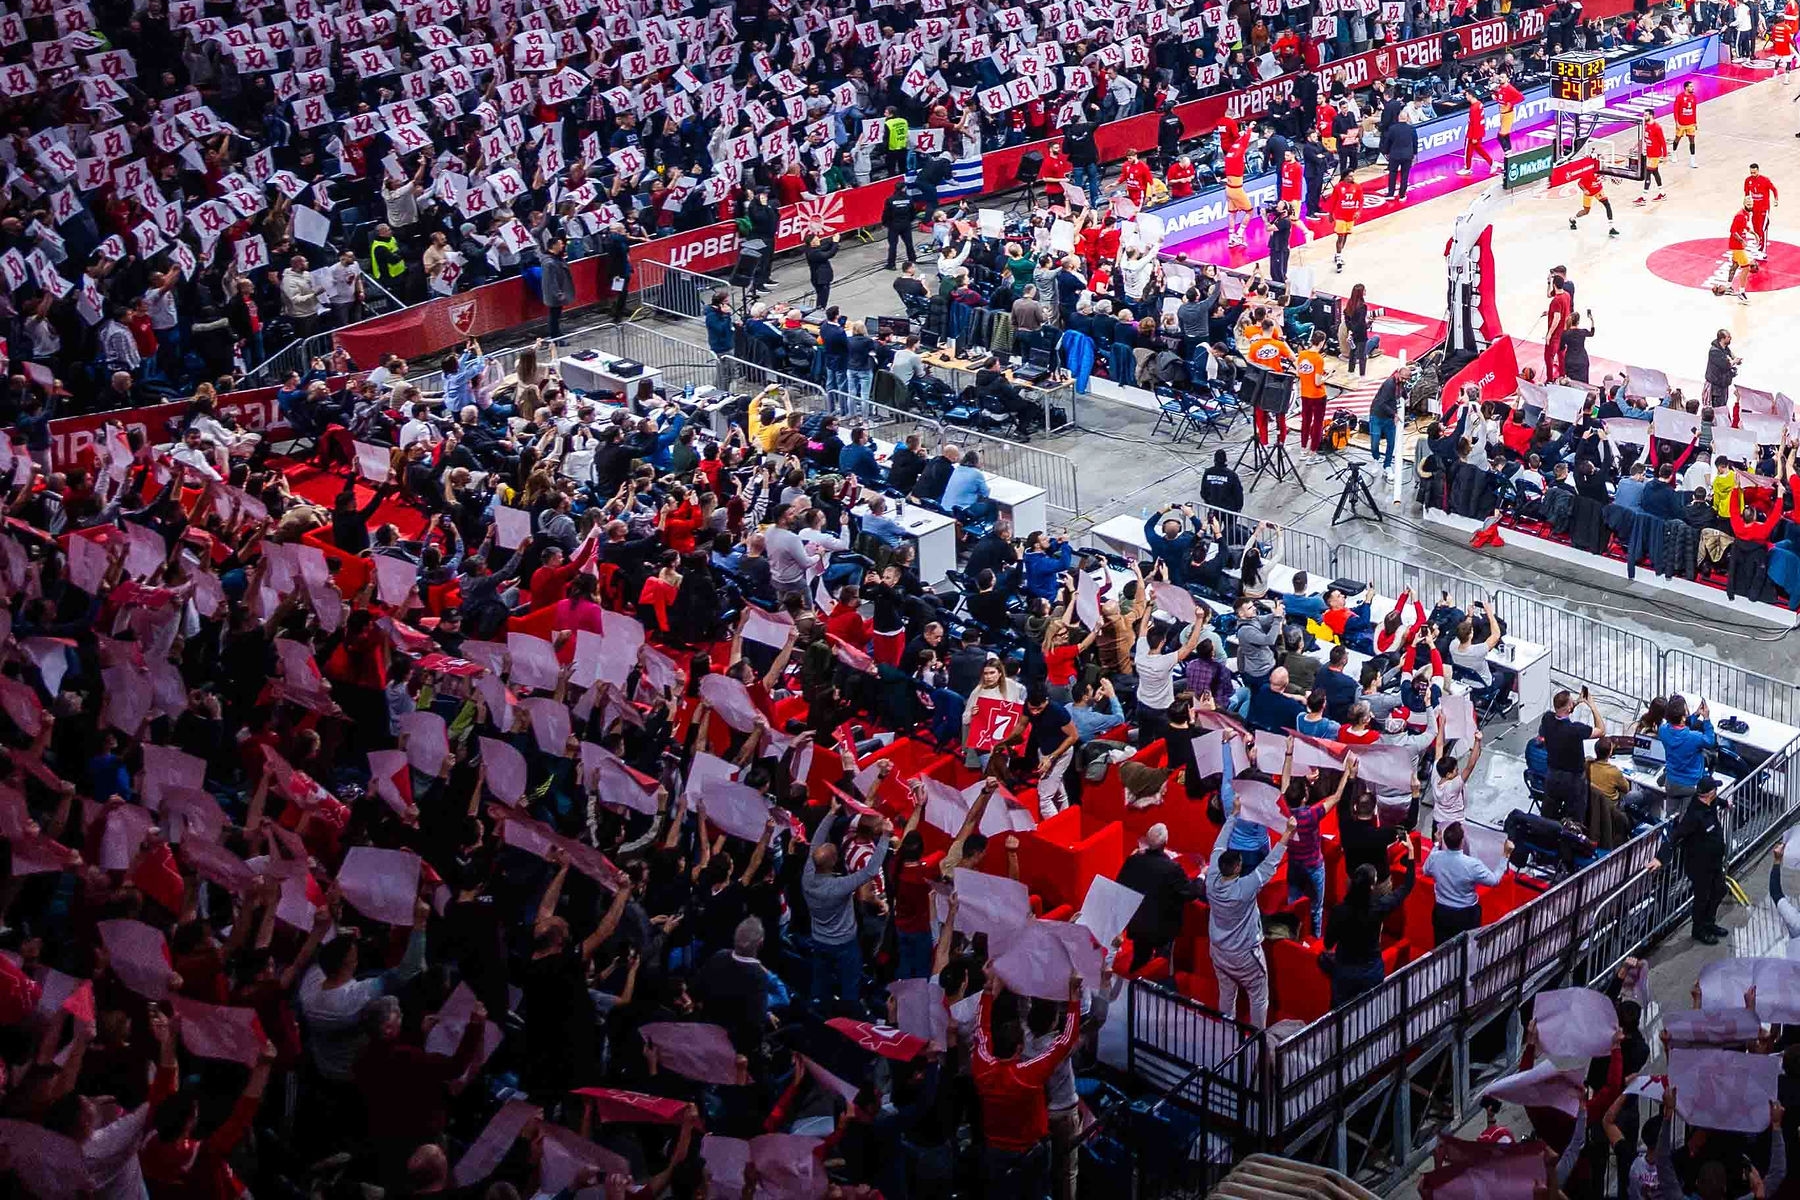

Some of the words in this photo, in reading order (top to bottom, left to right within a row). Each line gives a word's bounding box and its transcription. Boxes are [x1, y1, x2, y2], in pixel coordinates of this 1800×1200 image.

[1558, 61, 1582, 77] 3:27
[1561, 80, 1581, 99] 24
[1478, 371, 1496, 389] mts
[991, 714, 1012, 740] 7
